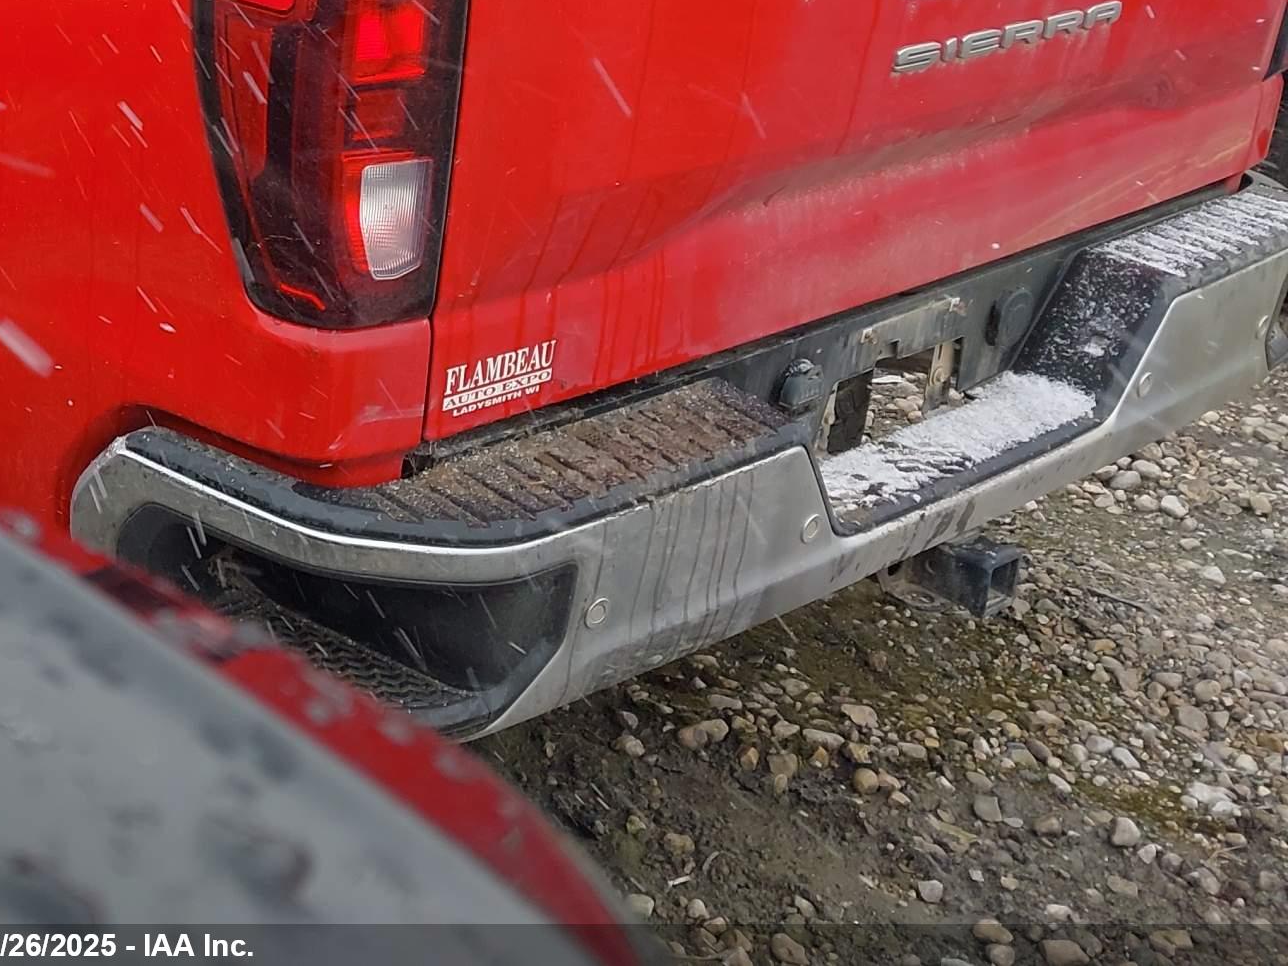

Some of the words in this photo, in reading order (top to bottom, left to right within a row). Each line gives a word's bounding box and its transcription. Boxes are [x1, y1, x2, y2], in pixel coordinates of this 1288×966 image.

[893, 0, 1122, 72] SIERRA
[444, 340, 557, 396] FLAMBEAU
[445, 387, 497, 409] AUTO
[502, 370, 552, 391] EXPO
[453, 392, 523, 417] LADYSMITH
[525, 384, 541, 397] WI
